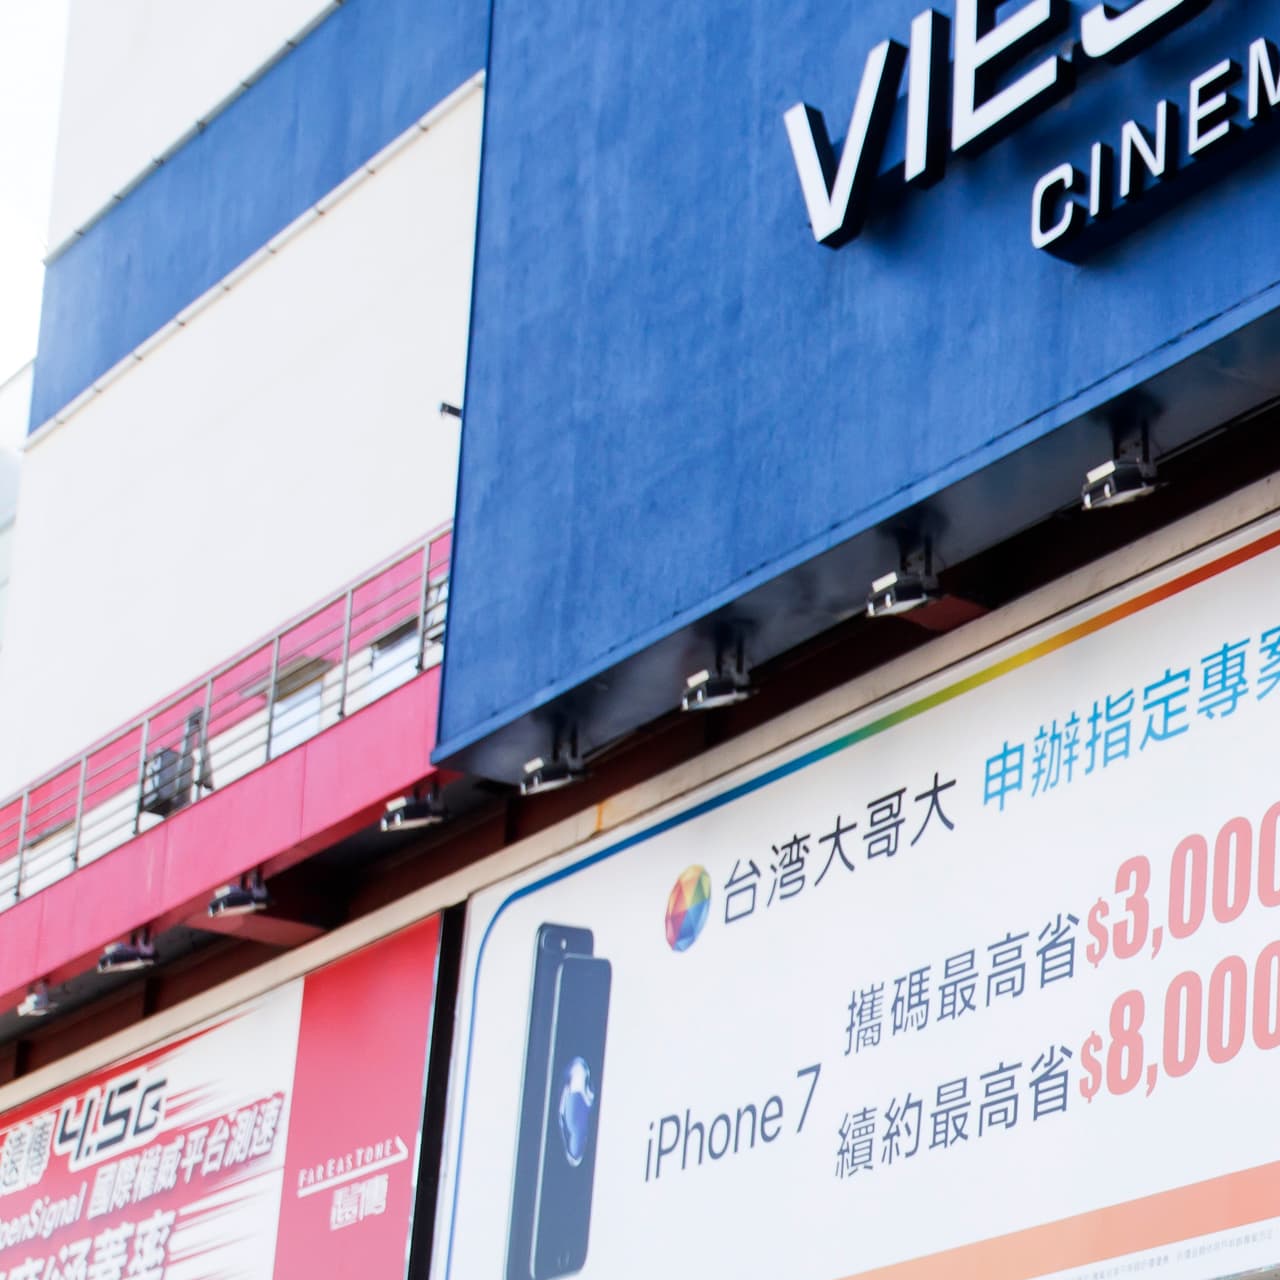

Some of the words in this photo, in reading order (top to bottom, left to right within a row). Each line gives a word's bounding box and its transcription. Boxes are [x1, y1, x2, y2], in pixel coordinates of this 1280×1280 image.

[844, 913, 1083, 1057] 攜碼最高省
[646, 1085, 785, 1182] iPhone
[795, 1065, 822, 1136] 7
[835, 1042, 1078, 1180] 續約最高省
